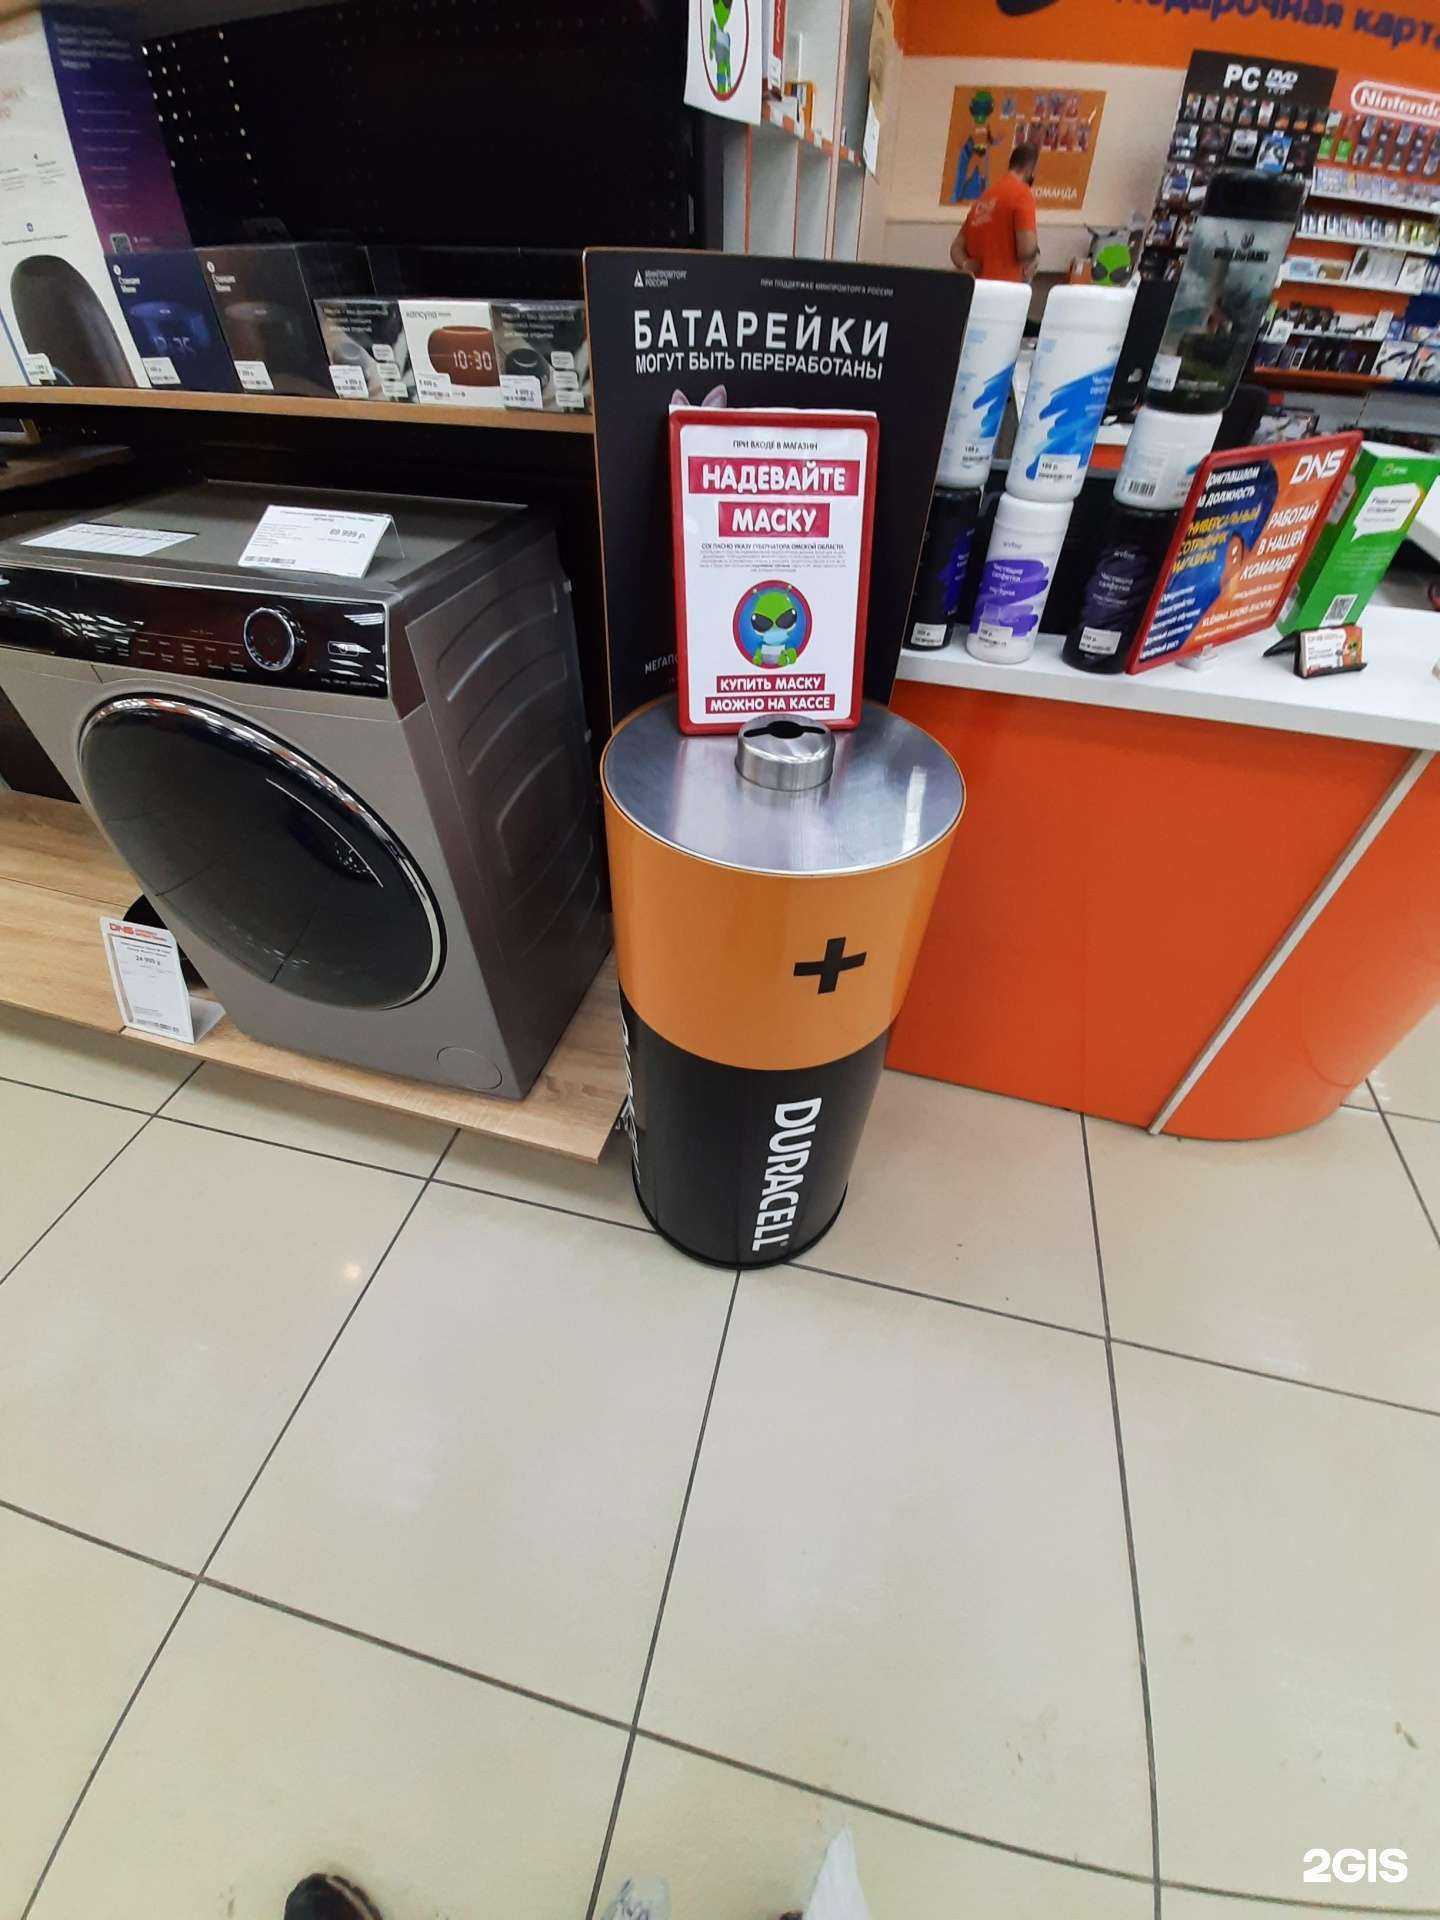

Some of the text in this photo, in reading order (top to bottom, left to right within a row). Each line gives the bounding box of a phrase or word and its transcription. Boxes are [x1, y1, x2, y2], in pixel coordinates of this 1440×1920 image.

[1353, 8, 1440, 47] карт
[1223, 63, 1261, 91] PC
[634, 304, 889, 357] БАТАРЕЙКИ
[452, 349, 493, 371] 10:30
[635, 352, 883, 380] МОГУТ БЫТЬ ПЕРЕРАБОТАНЫ
[733, 440, 749, 449] ПРИ
[750, 441, 775, 450] ВХОДЕ
[783, 442, 818, 451] МАГАЗИН
[702, 460, 846, 493] НАДЕВАЙТЕ
[1289, 449, 1346, 485] DNS
[732, 508, 817, 532] МАСКУ
[1266, 500, 1319, 530] РАБОТАЙ
[1257, 538, 1268, 555] В
[720, 676, 822, 691] КУПИТЬ МАСКУ
[710, 696, 830, 712] МОЖНО НА КАССЕ
[751, 1097, 823, 1251] DURACELL
